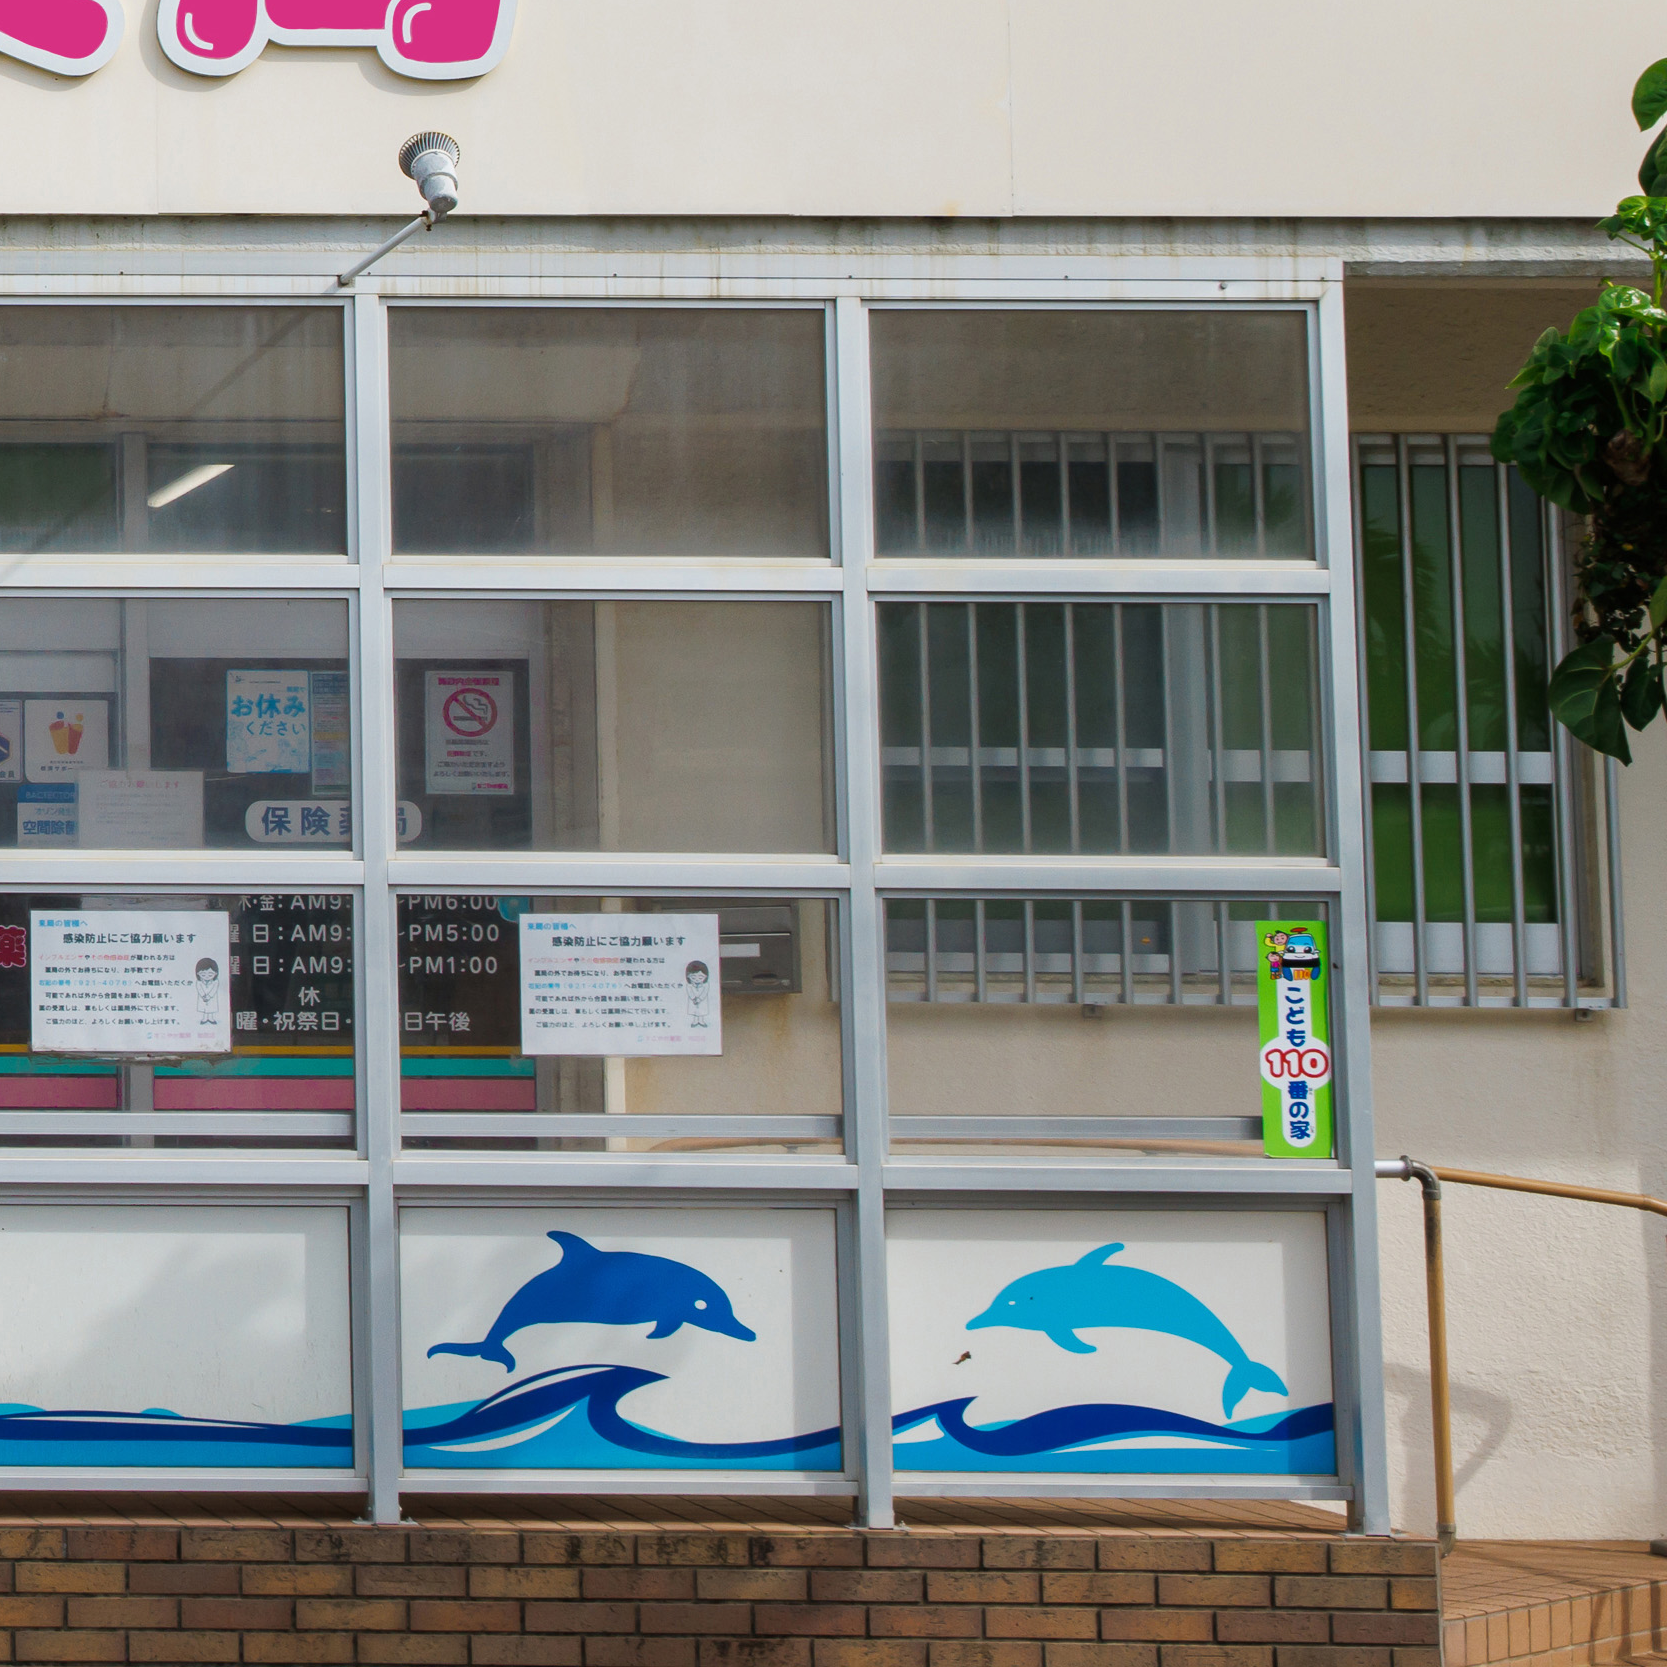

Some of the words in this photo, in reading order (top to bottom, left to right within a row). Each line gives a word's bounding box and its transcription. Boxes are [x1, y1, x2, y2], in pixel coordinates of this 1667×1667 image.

[231, 694, 306, 718] お休み
[246, 722, 306, 736] ください
[63, 933, 196, 943] 感染防止にご協力願います
[552, 936, 686, 946] 感染防止にご協力願います
